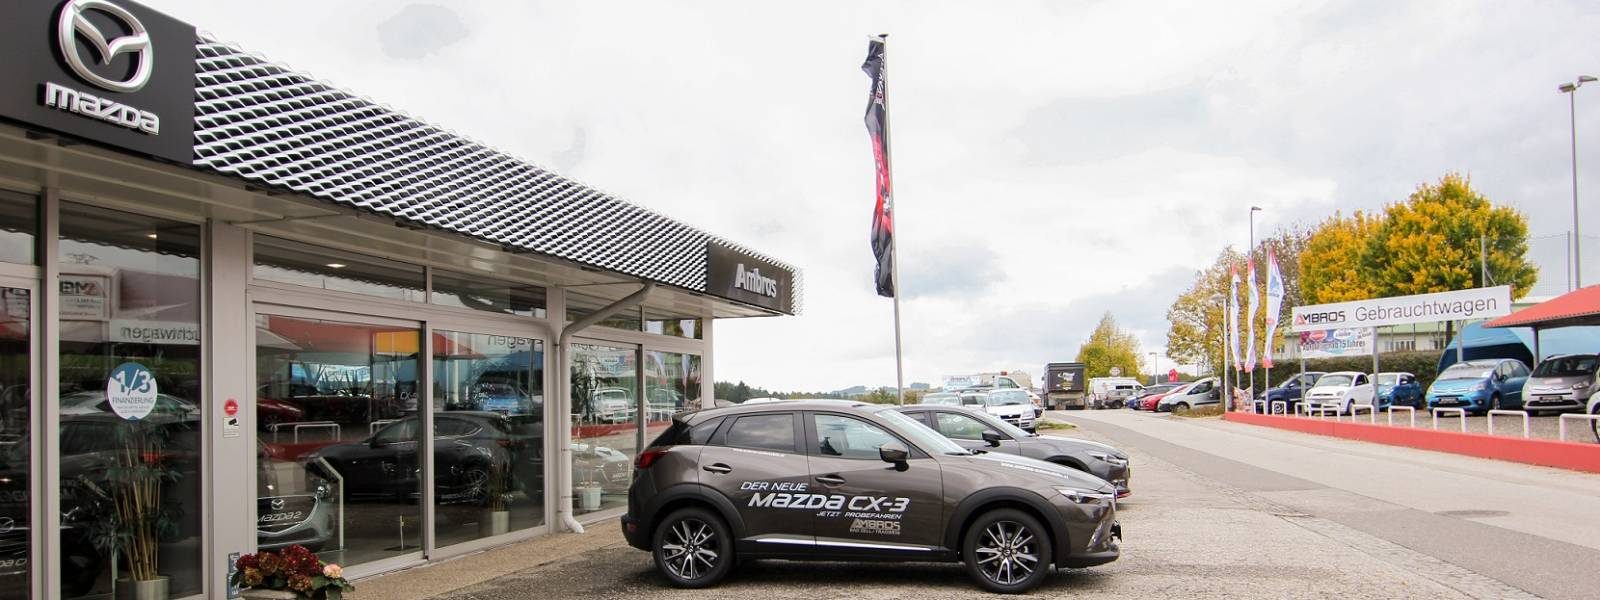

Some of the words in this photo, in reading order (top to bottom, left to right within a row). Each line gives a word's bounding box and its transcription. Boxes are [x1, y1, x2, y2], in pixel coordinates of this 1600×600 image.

[734, 263, 777, 298] Ambros
[1295, 310, 1346, 325] AMBROS
[1355, 298, 1497, 321] Gebrauchtwagen
[116, 369, 150, 395] 1/3
[740, 481, 768, 490] DER
[771, 482, 807, 491] NEUE
[848, 496, 910, 512] CX-3
[844, 511, 902, 519] PROBEFAHREN
[850, 519, 900, 530] AMBROS
